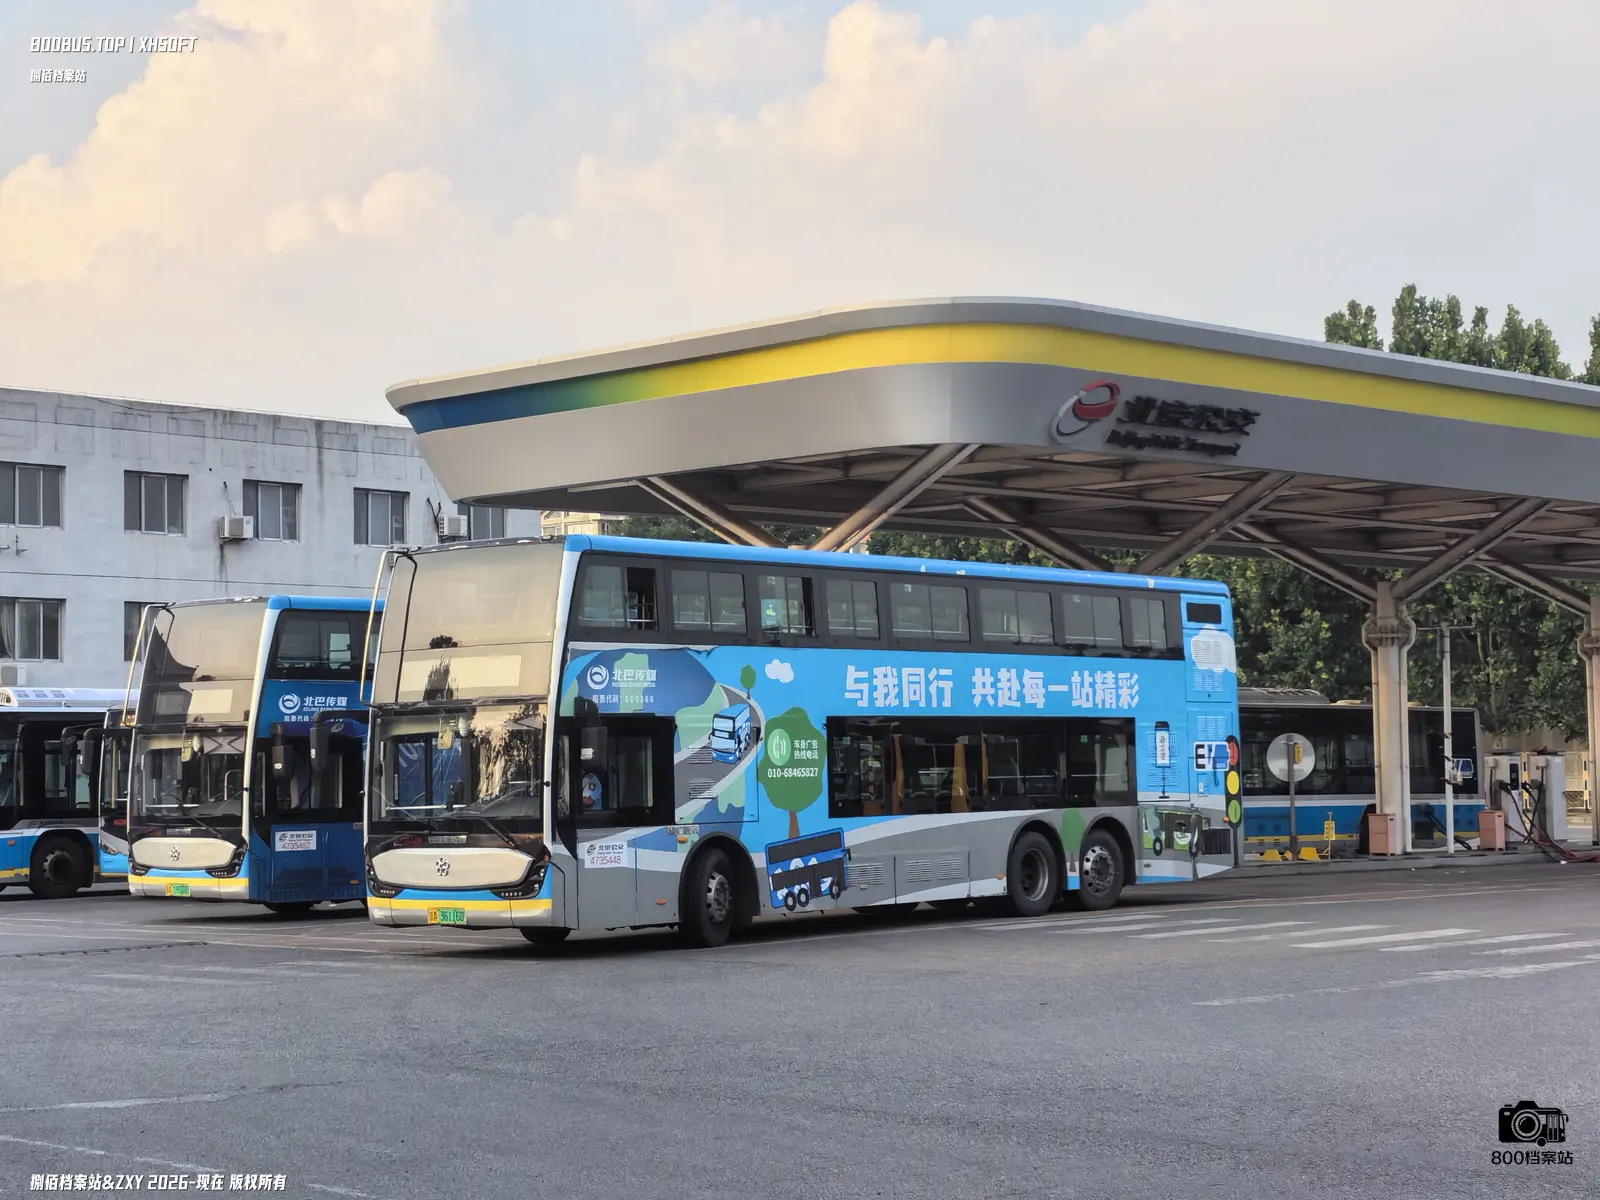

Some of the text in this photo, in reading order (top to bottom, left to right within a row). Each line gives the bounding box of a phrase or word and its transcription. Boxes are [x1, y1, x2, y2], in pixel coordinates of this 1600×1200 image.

[845, 664, 1140, 709] 与我同行 共赴每一站精彩
[303, 696, 348, 707] 北巴传媒
[793, 740, 818, 749] 车身广告
[767, 767, 819, 778] 010-68465827
[589, 856, 621, 865] 4735448
